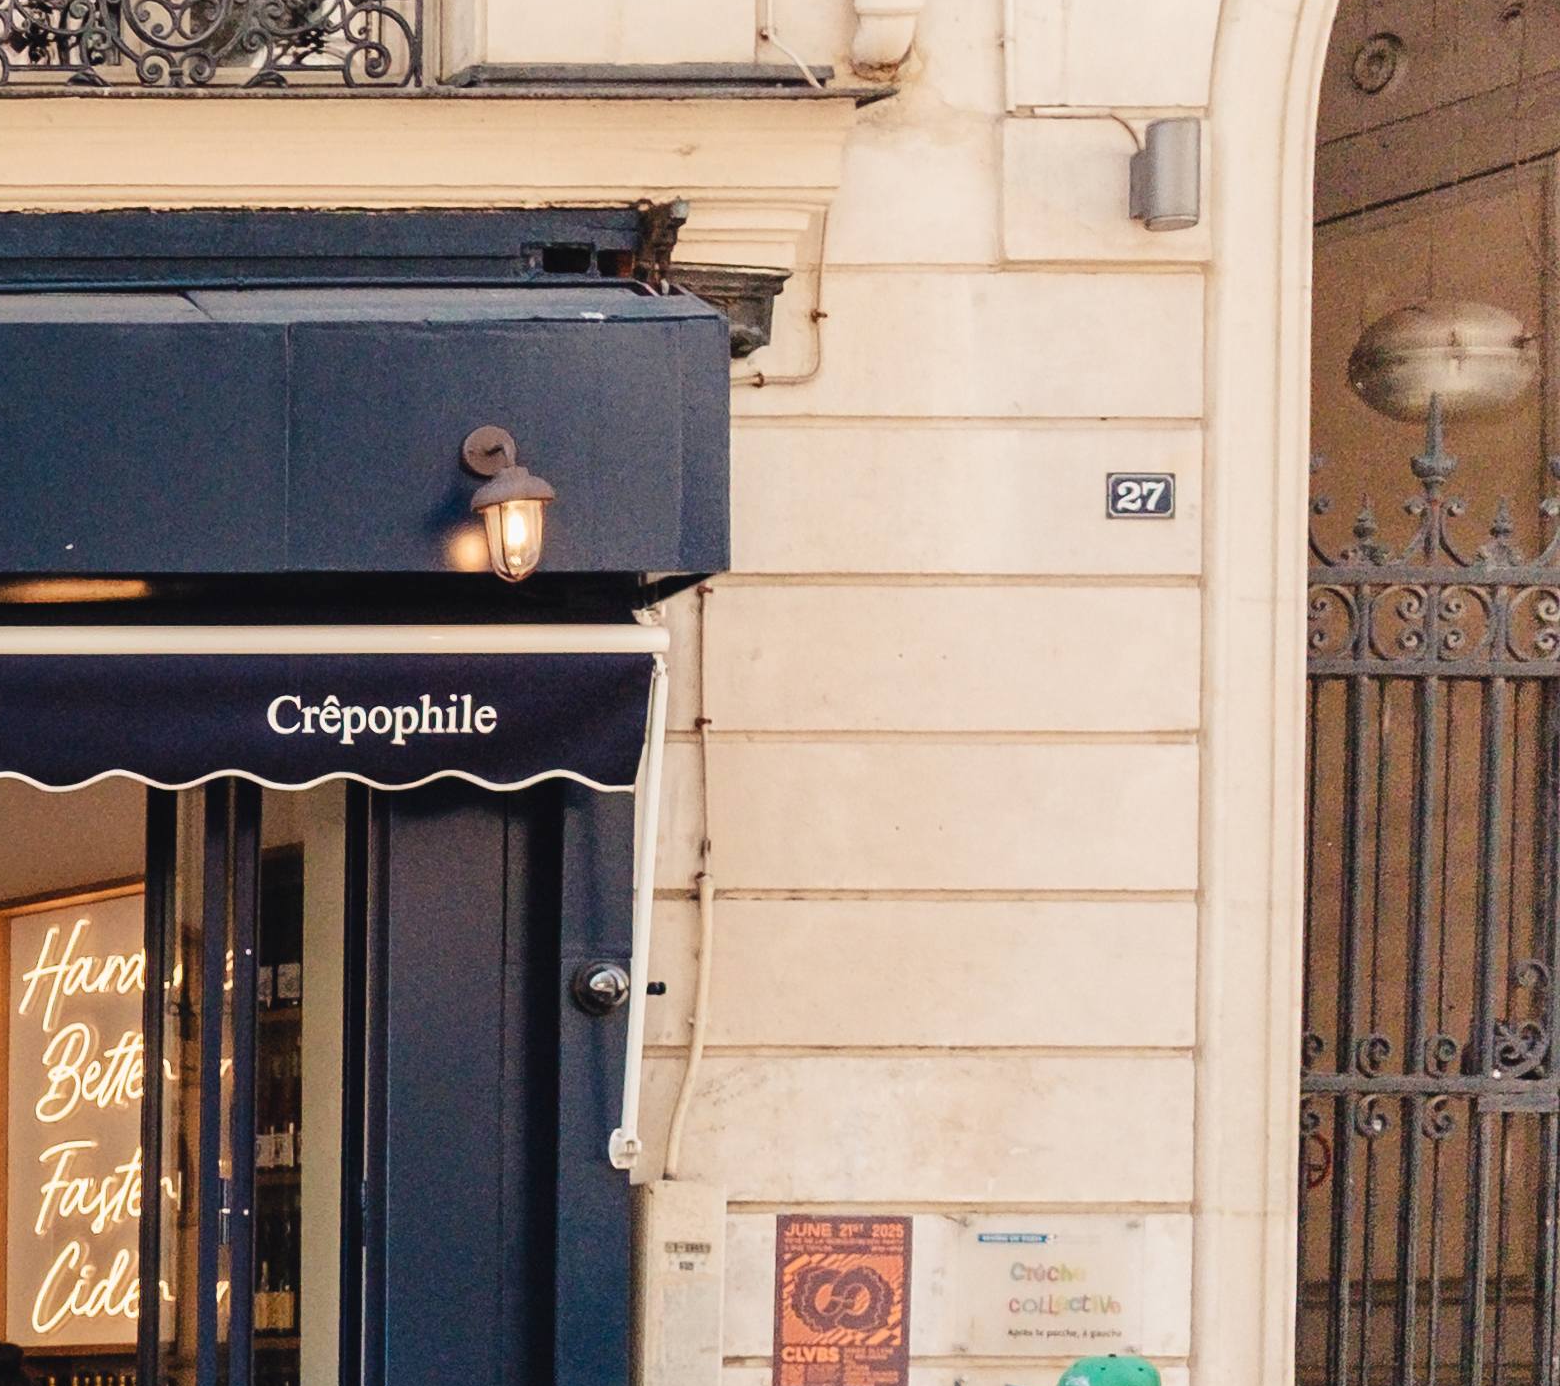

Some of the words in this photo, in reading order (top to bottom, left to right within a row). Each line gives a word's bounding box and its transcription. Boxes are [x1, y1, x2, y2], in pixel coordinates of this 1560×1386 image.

[1116, 481, 1165, 511] 27
[266, 693, 498, 745] Crêpophile
[784, 1222, 832, 1238] JUNE
[872, 1223, 904, 1238] 2025
